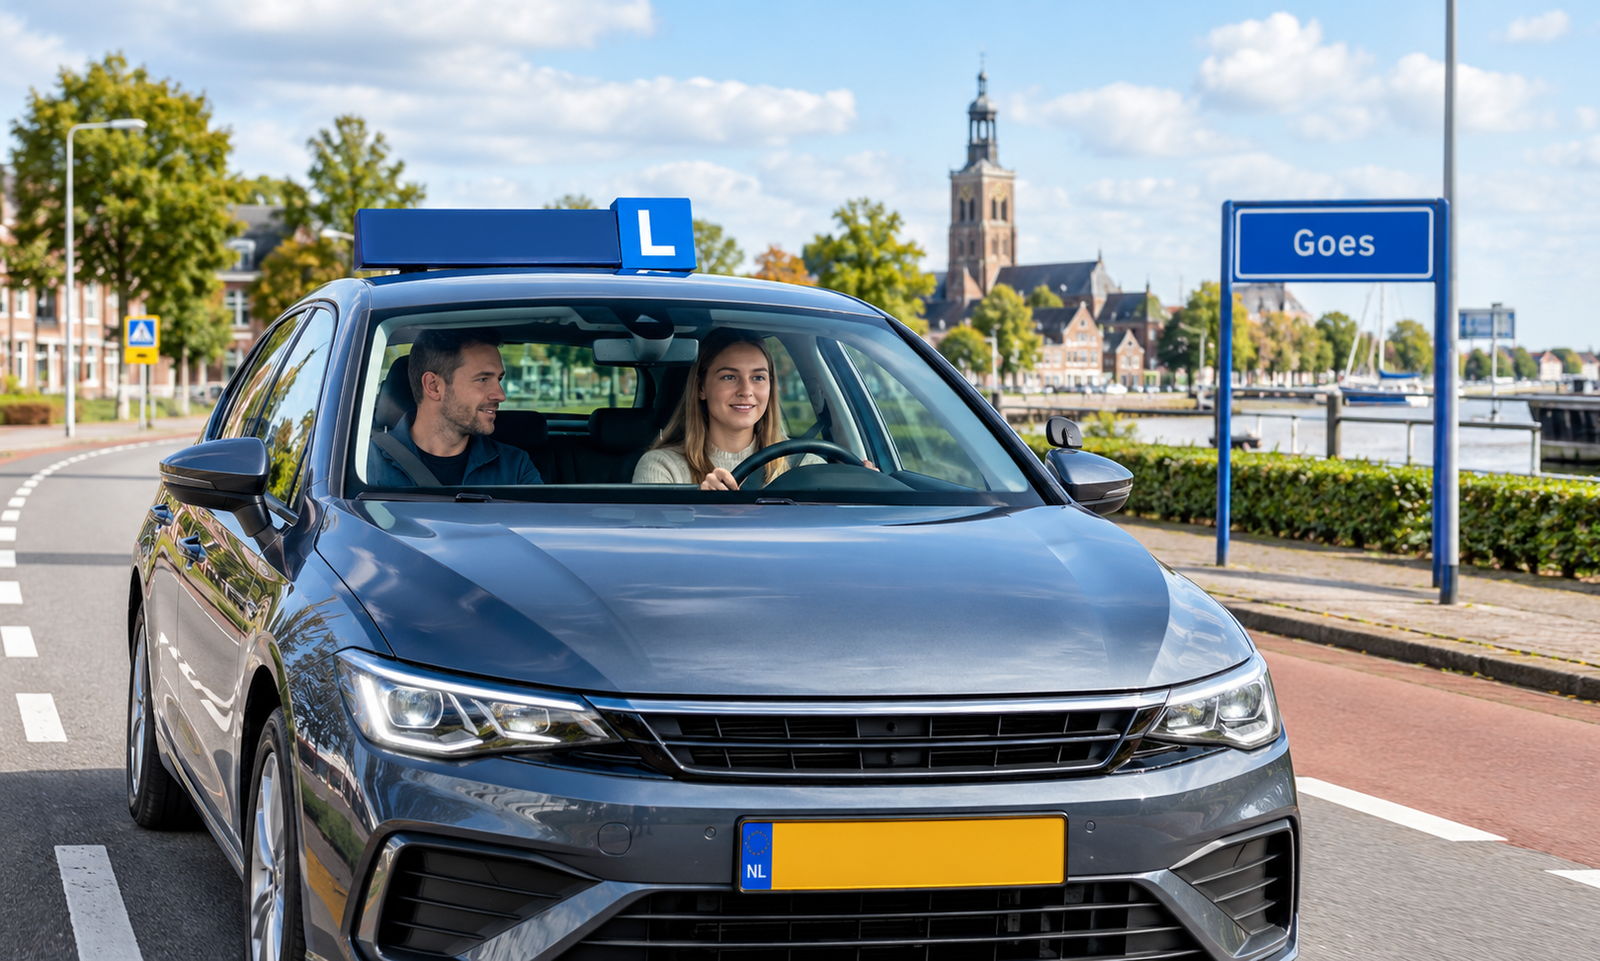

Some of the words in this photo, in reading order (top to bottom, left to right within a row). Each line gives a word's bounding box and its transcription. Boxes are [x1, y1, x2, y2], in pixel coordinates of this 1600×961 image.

[637, 209, 676, 256] L
[1293, 229, 1375, 256] Goes
[747, 864, 767, 878] NL
